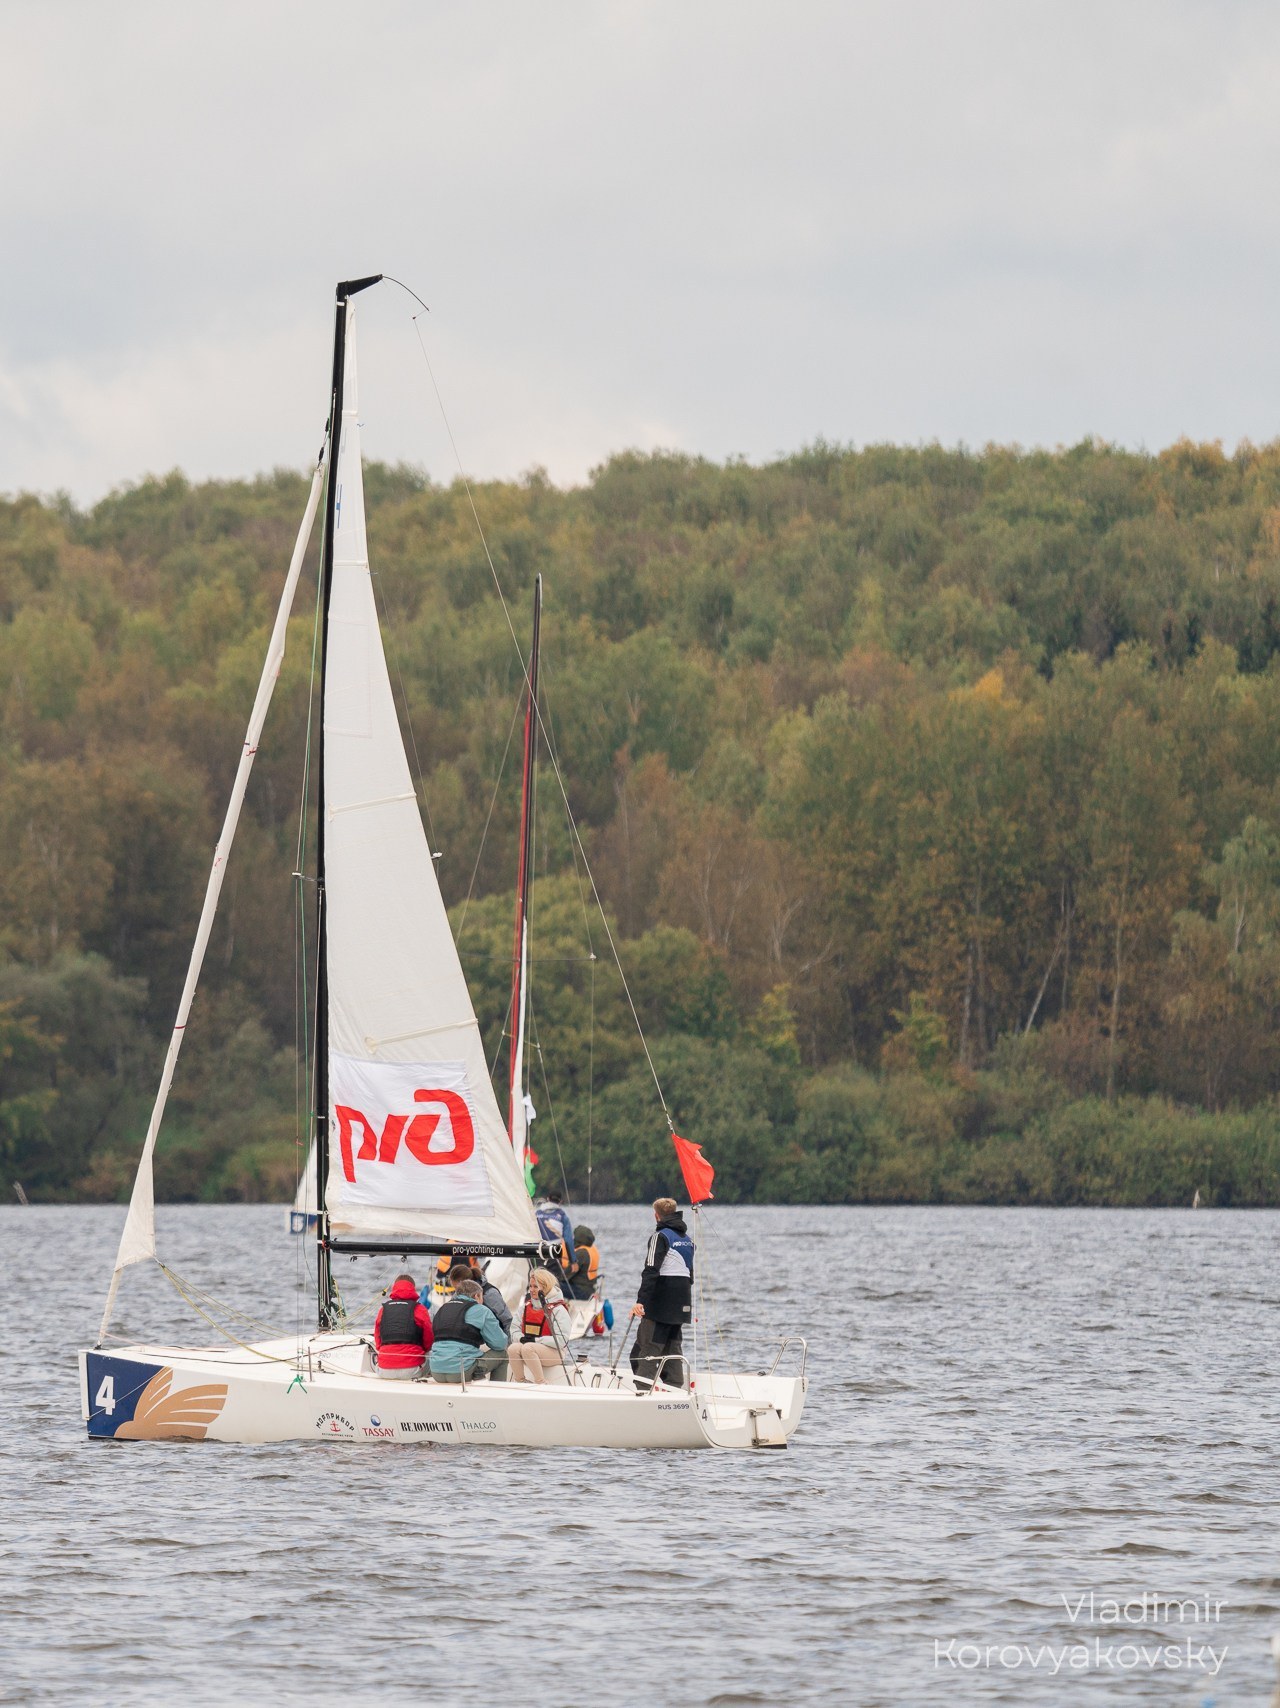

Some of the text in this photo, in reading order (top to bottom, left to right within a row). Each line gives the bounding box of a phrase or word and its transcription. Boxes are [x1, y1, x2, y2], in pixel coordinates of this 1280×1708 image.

[452, 1245, 504, 1256] pro-yachting.ru
[95, 1375, 116, 1416] 4
[701, 1409, 708, 1421] 4
[315, 1412, 355, 1432] МОРПРИБОР
[400, 1422, 453, 1432] ВЕДОМОСТИ
[460, 1421, 497, 1430] THALGO
[362, 1427, 395, 1438] TASSAY
